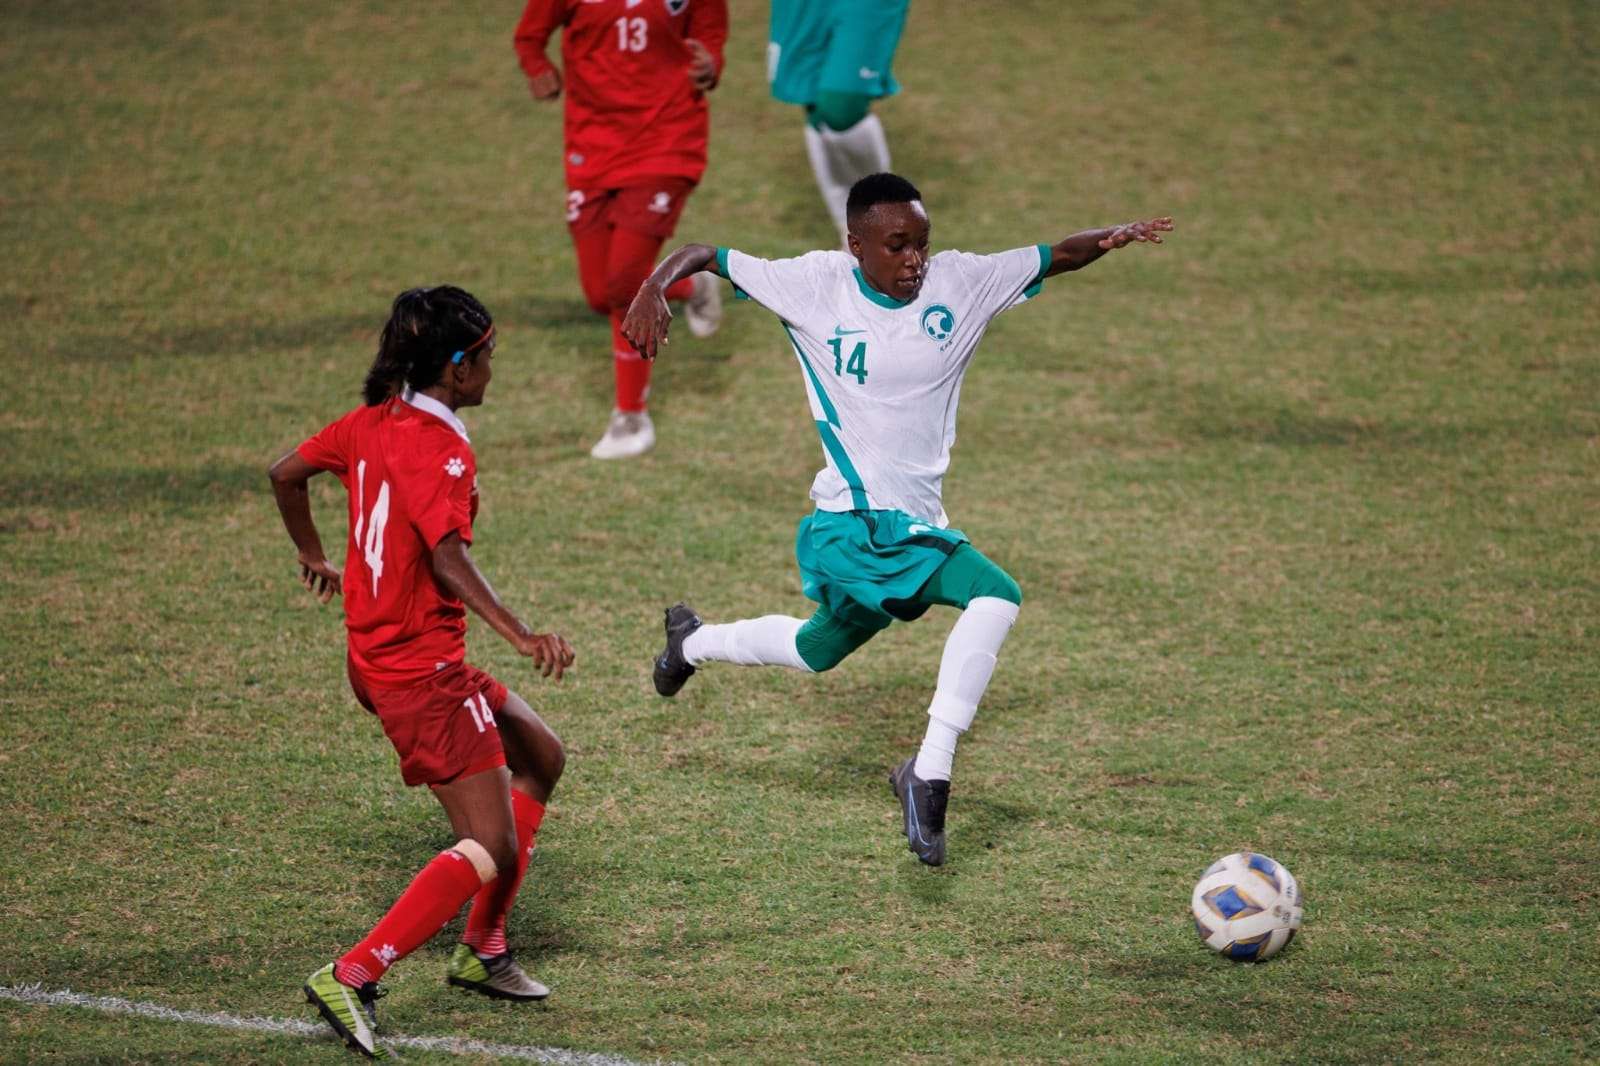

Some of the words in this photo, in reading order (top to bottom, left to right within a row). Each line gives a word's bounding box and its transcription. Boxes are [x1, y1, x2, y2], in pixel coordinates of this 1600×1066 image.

[616, 17, 648, 52] 13
[827, 337, 868, 385] 14
[355, 460, 390, 598] 14
[463, 691, 497, 733] 14
